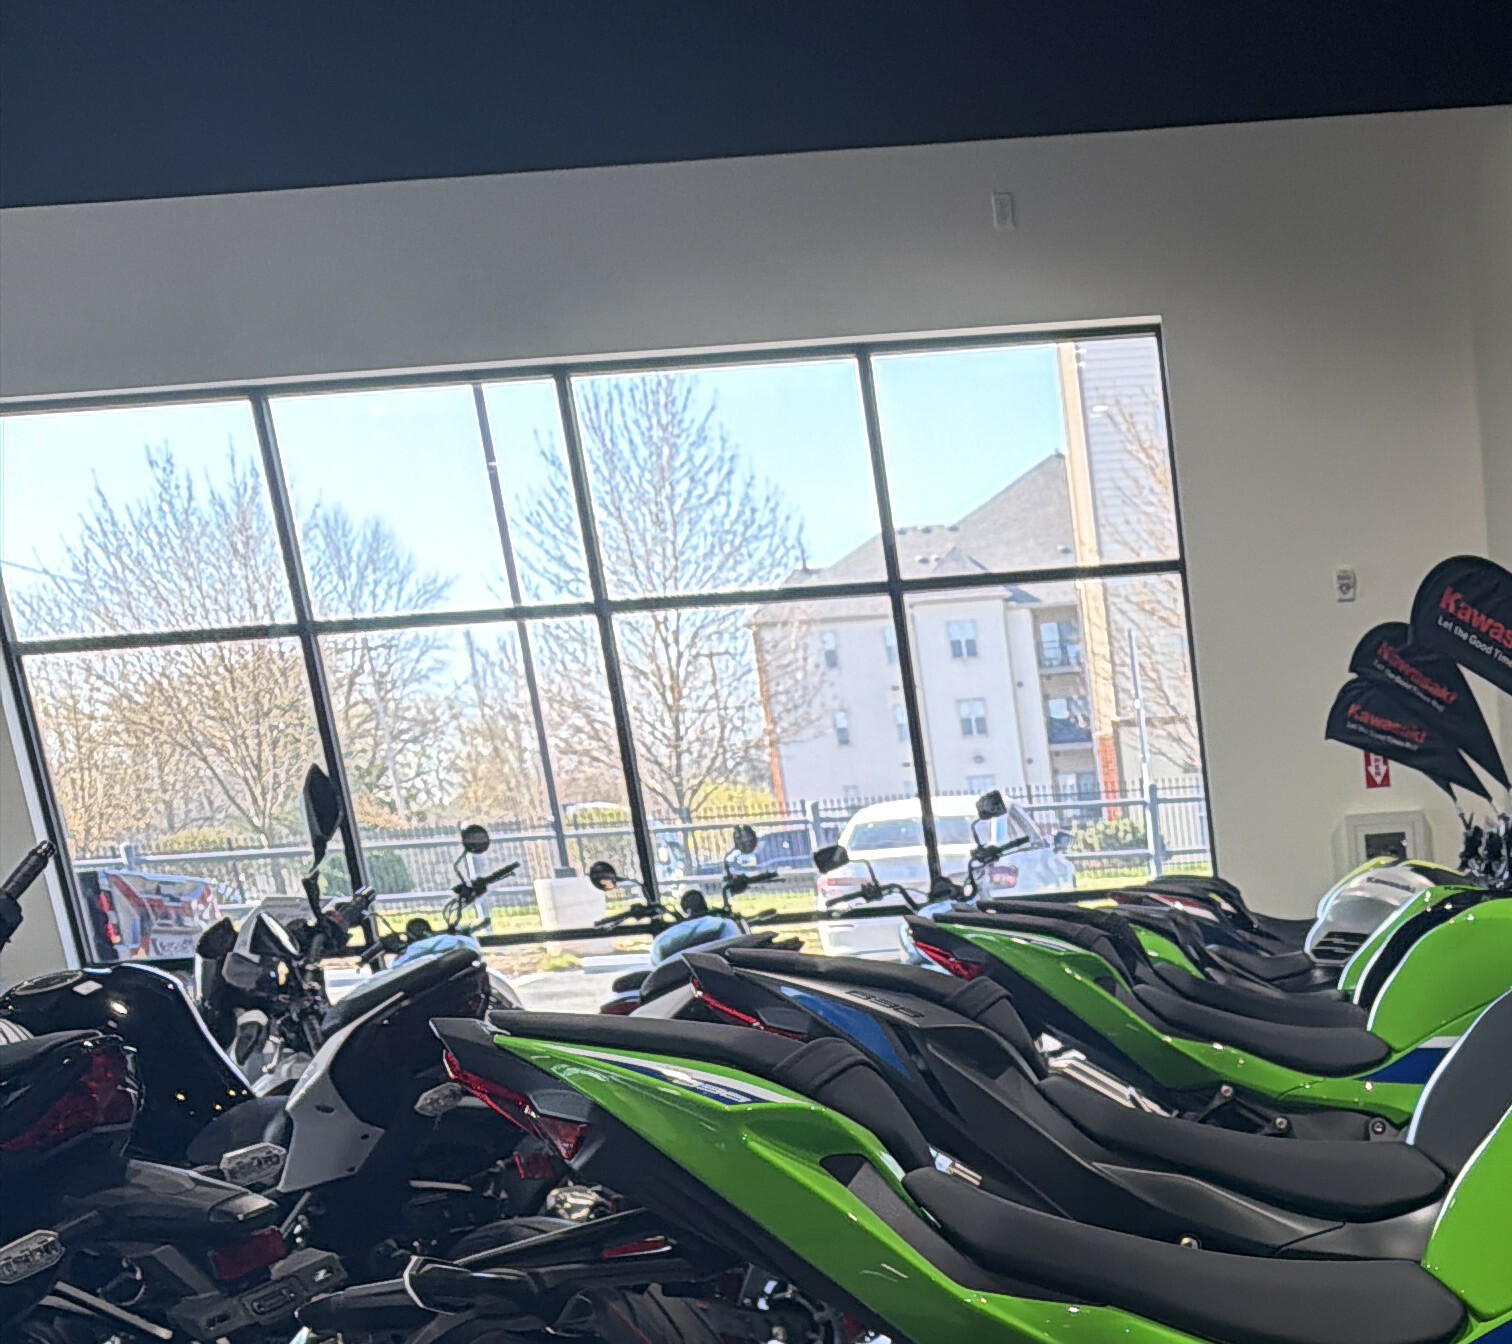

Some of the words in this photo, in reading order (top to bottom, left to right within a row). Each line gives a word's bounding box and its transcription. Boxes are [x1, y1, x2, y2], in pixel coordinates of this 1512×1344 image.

[1437, 614, 1453, 631] Let
[1453, 625, 1469, 641] the
[1468, 634, 1494, 655] Good
